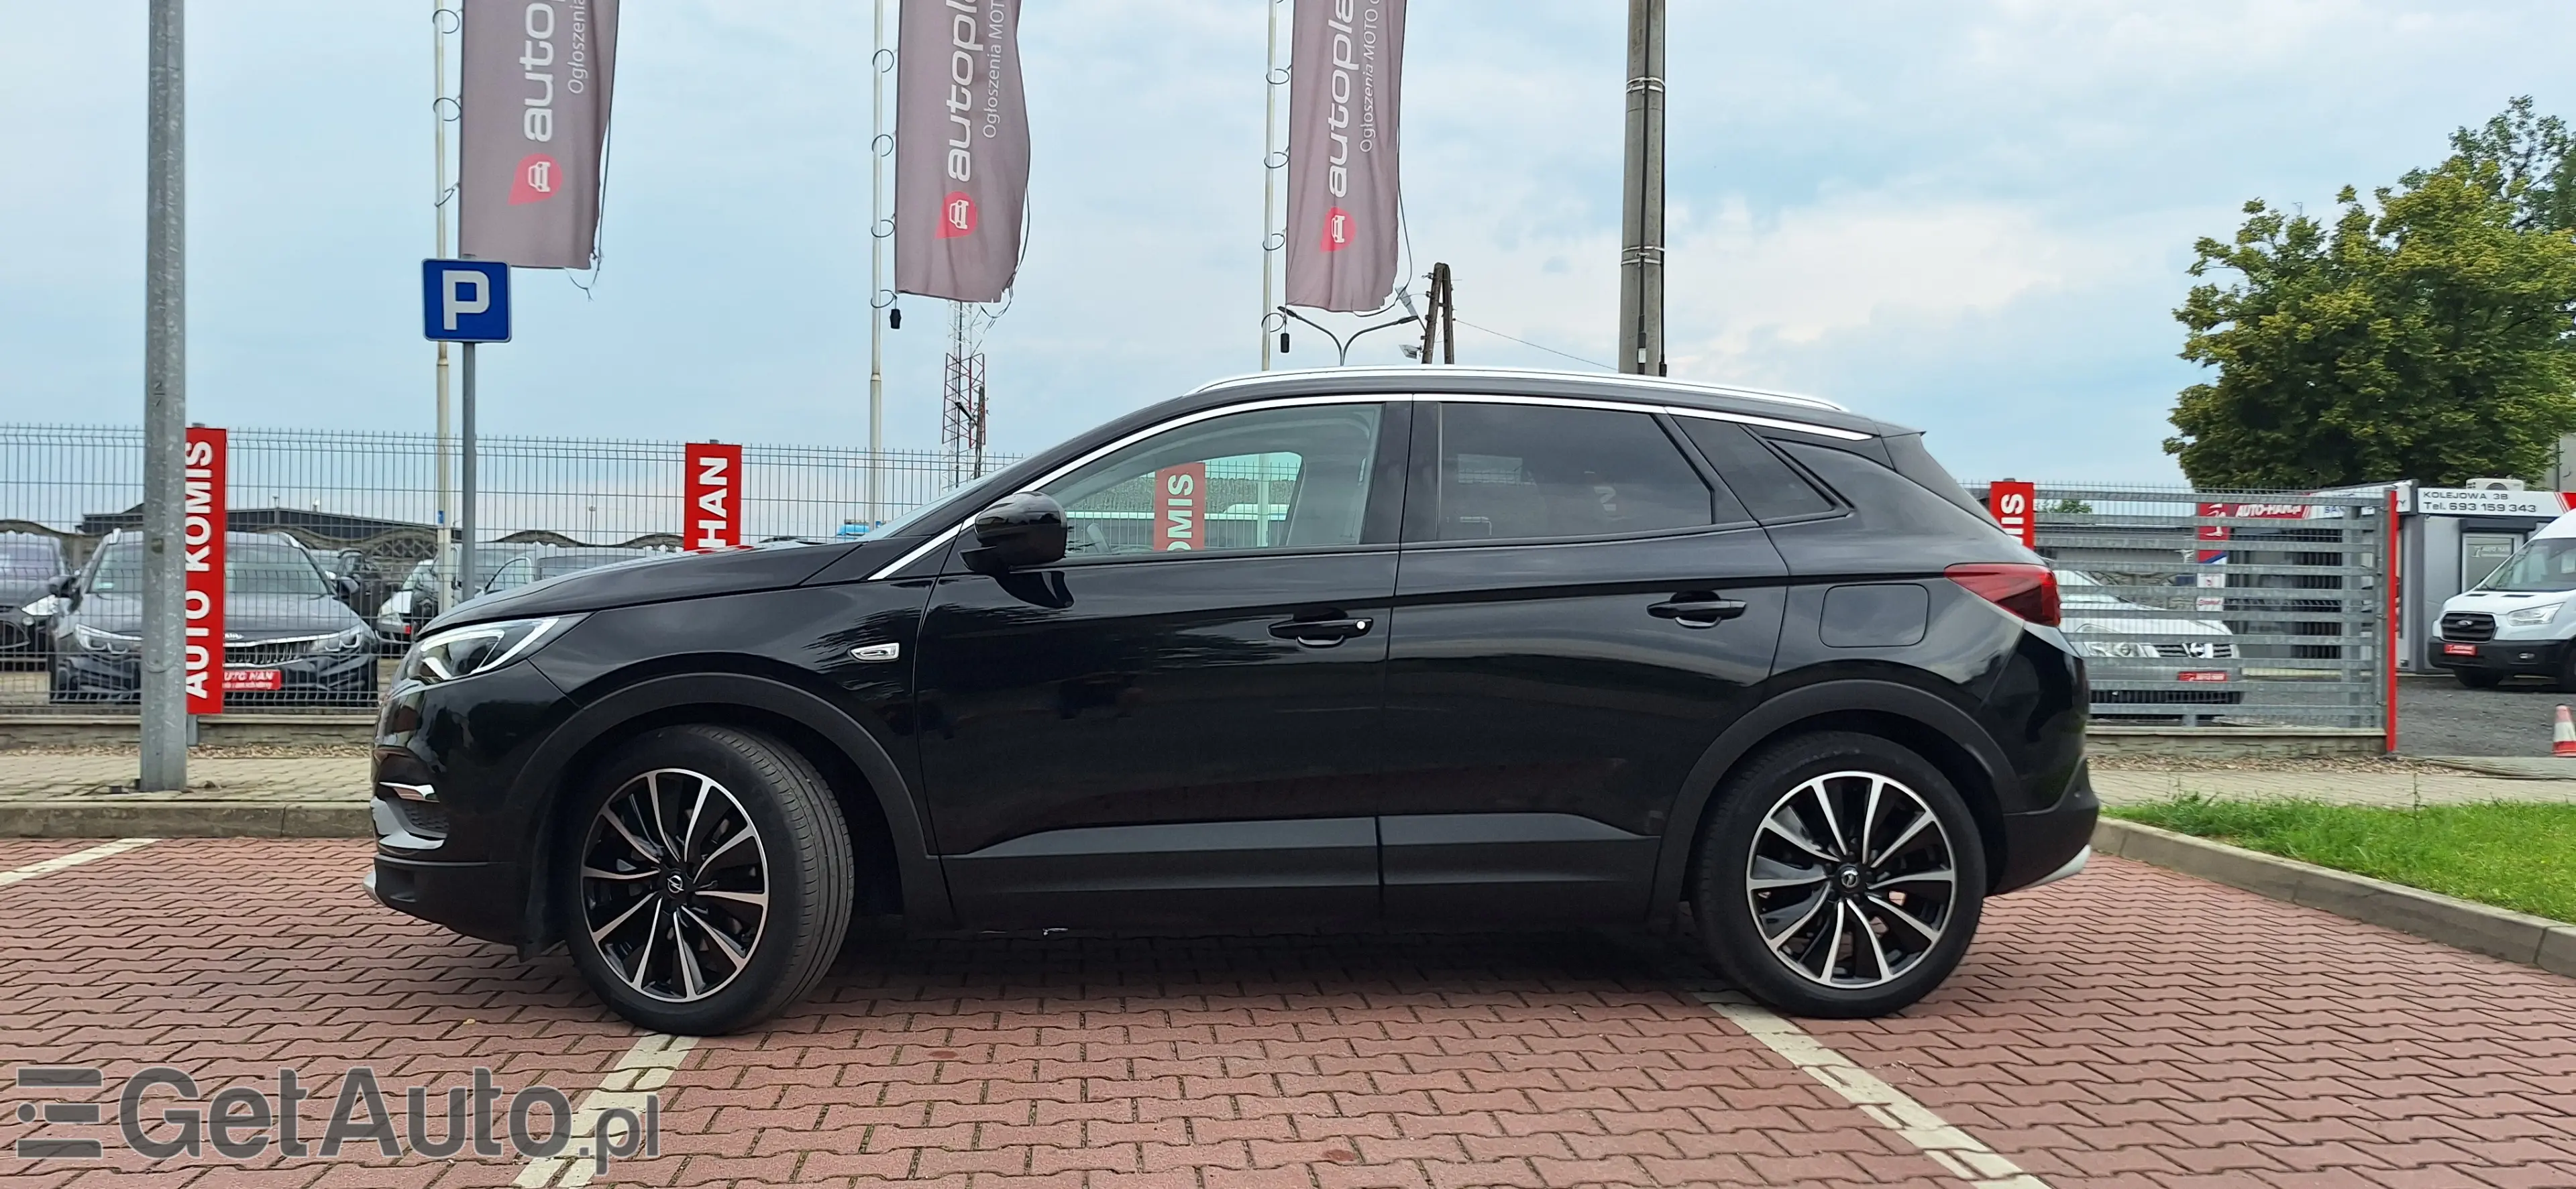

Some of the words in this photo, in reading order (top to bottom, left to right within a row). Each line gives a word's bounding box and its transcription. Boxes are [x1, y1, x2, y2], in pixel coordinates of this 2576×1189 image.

[988, 0, 1005, 40] MOT
[1363, 8, 1379, 61] MOTO
[519, 0, 566, 142] auto
[945, 0, 983, 182] autopl
[983, 44, 1002, 138] Ogłoszenia
[1359, 64, 1377, 153] Ogłoszenia
[442, 269, 490, 331] P
[185, 441, 212, 571] KOMIS
[698, 457, 728, 549] HAN
[2423, 491, 2487, 500] KOLEJOWA
[2423, 502, 2447, 510] Tel.
[2449, 502, 2477, 511] 693
[2481, 503, 2506, 512] 159
[2508, 504, 2537, 513] 343
[185, 591, 210, 699] AUTO
[224, 671, 248, 681] UTO
